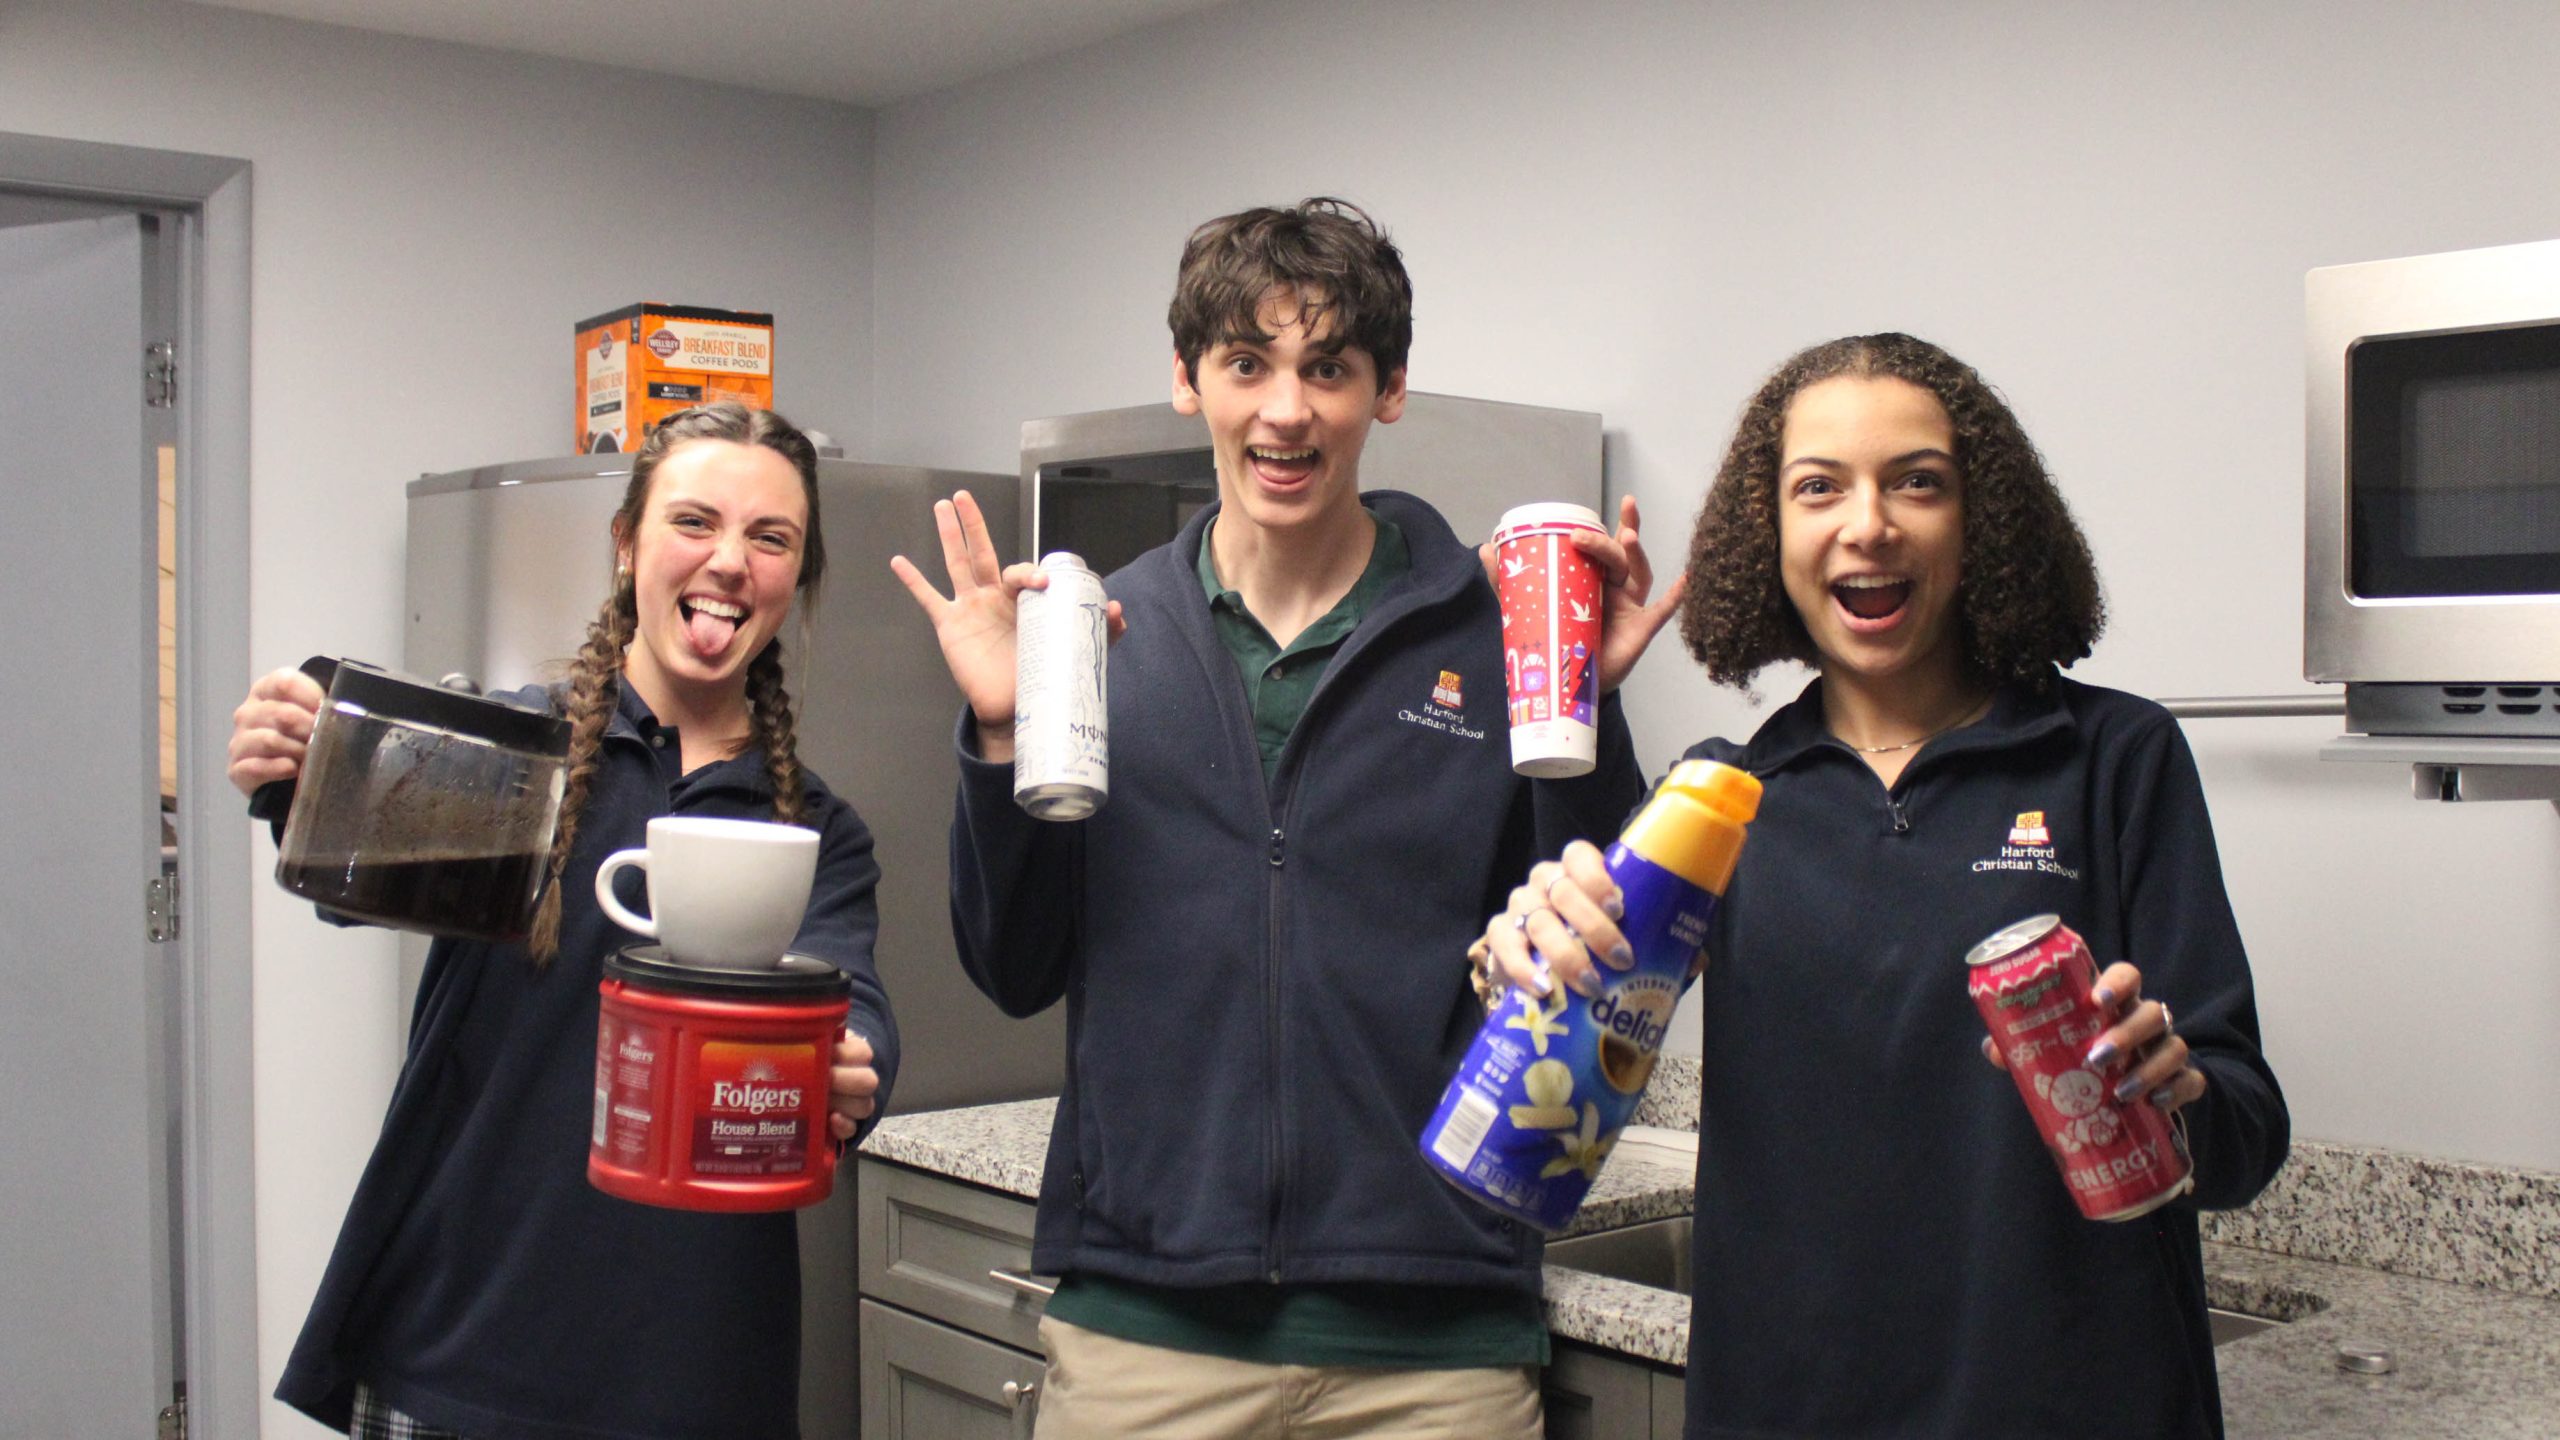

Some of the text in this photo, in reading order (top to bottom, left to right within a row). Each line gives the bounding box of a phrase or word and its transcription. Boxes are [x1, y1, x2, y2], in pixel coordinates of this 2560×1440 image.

[684, 336, 766, 359] BREAKFAST BLEND
[691, 355, 759, 369] COFFEE PODS
[1423, 702, 1464, 724] Harford
[1398, 709, 1485, 740] Christian School
[2001, 845, 2055, 859] Harford
[1972, 859, 2079, 881] Christian School
[711, 1081, 802, 1115] Folgers
[711, 1120, 797, 1136] House Blend
[2069, 1137, 2159, 1190] ENERGY
